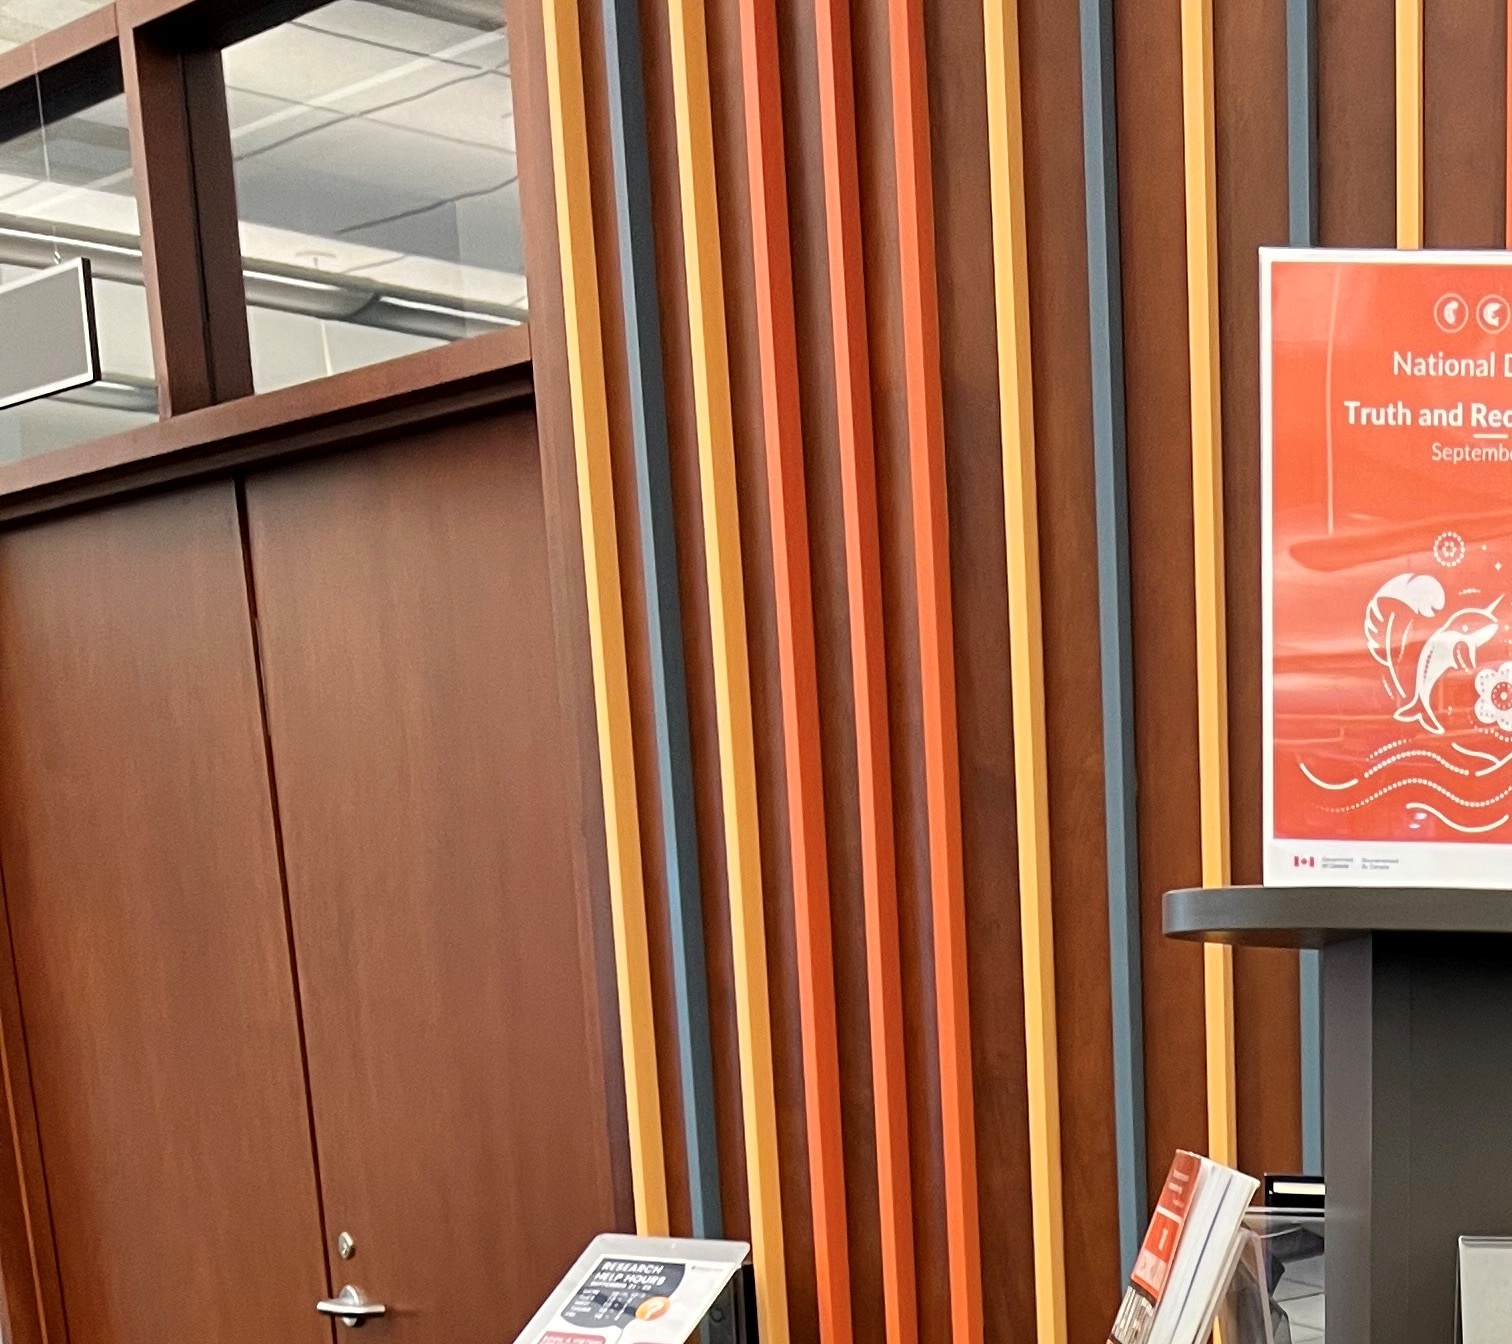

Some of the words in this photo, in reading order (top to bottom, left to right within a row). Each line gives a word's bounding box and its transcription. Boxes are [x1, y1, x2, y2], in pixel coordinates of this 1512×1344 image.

[1393, 351, 1495, 377] National
[1344, 401, 1411, 426] Truth
[1418, 402, 1463, 427] and
[601, 1261, 664, 1274] RESEARCH
[593, 1271, 624, 1282] HELP
[623, 1275, 666, 1286] HOURS
